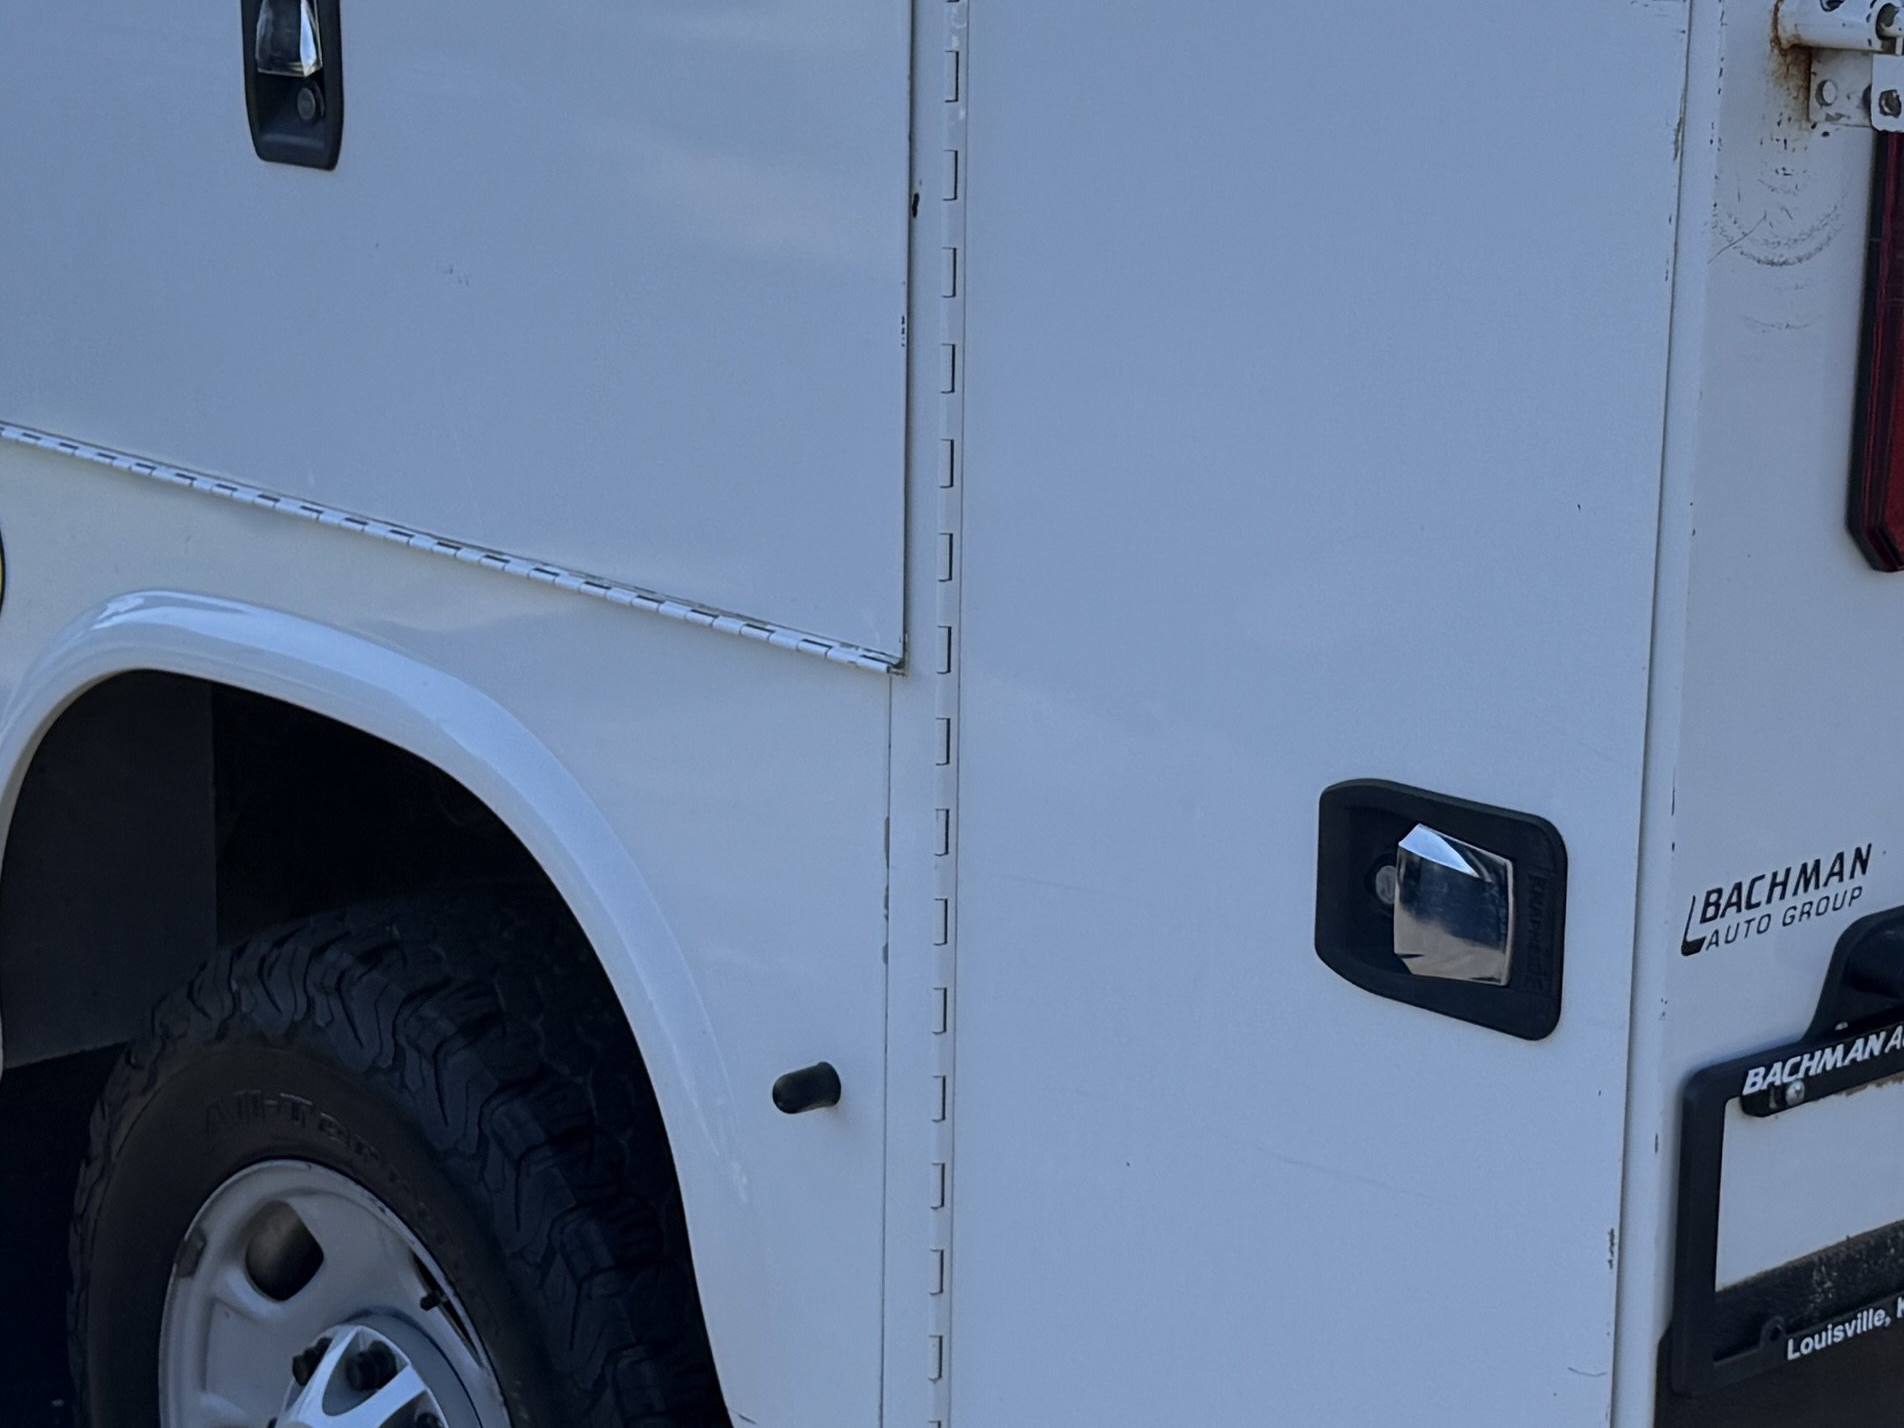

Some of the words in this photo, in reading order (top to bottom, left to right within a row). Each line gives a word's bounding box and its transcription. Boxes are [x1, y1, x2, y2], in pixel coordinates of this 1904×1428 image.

[1699, 843, 1872, 924] BACHMAN
[1705, 913, 1772, 952] AUTO
[1781, 886, 1863, 927] GROUP
[1742, 1031, 1887, 1096] BACHMAN
[1786, 1307, 1892, 1361] Louisville,
